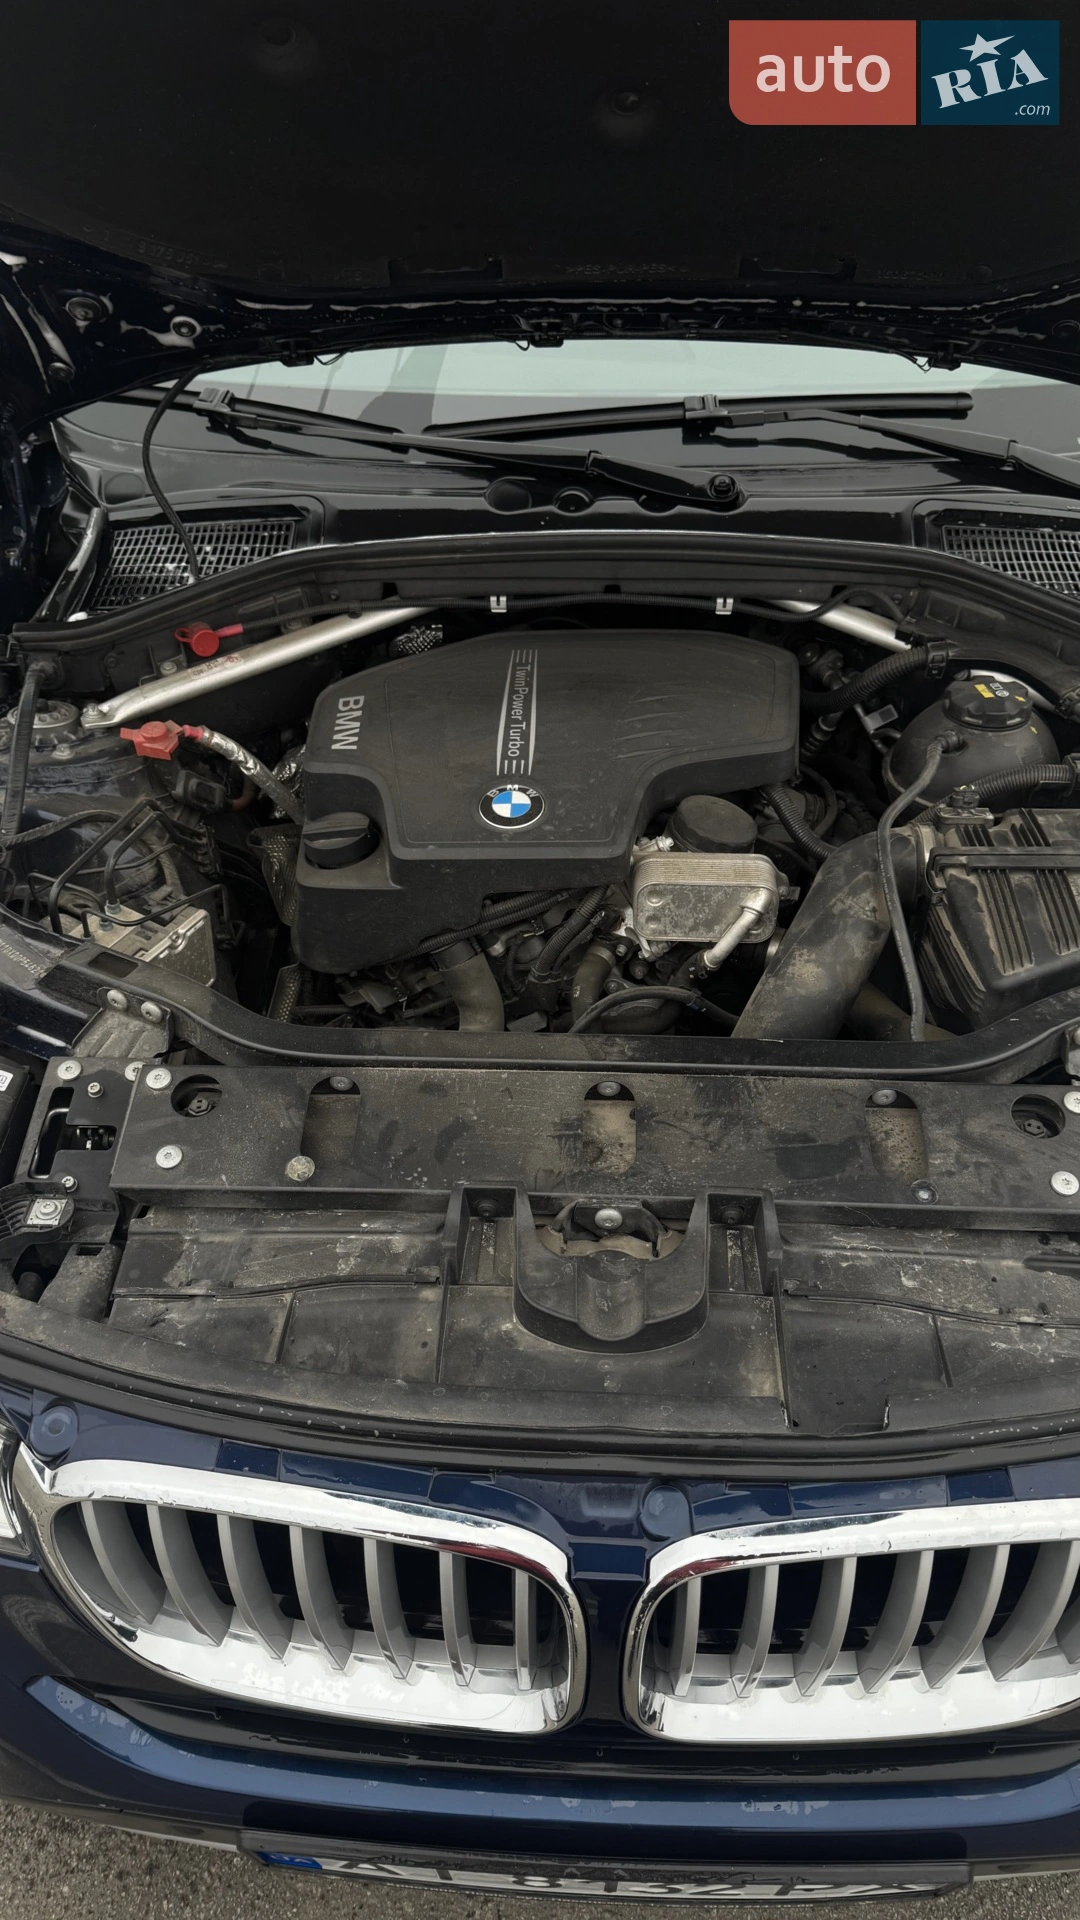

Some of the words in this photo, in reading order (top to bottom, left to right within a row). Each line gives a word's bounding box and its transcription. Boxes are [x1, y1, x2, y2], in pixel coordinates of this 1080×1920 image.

[511, 664, 531, 721] TwinPower
[331, 695, 365, 750] BMW
[507, 721, 527, 758] Turbo
[486, 784, 540, 798] BMW
